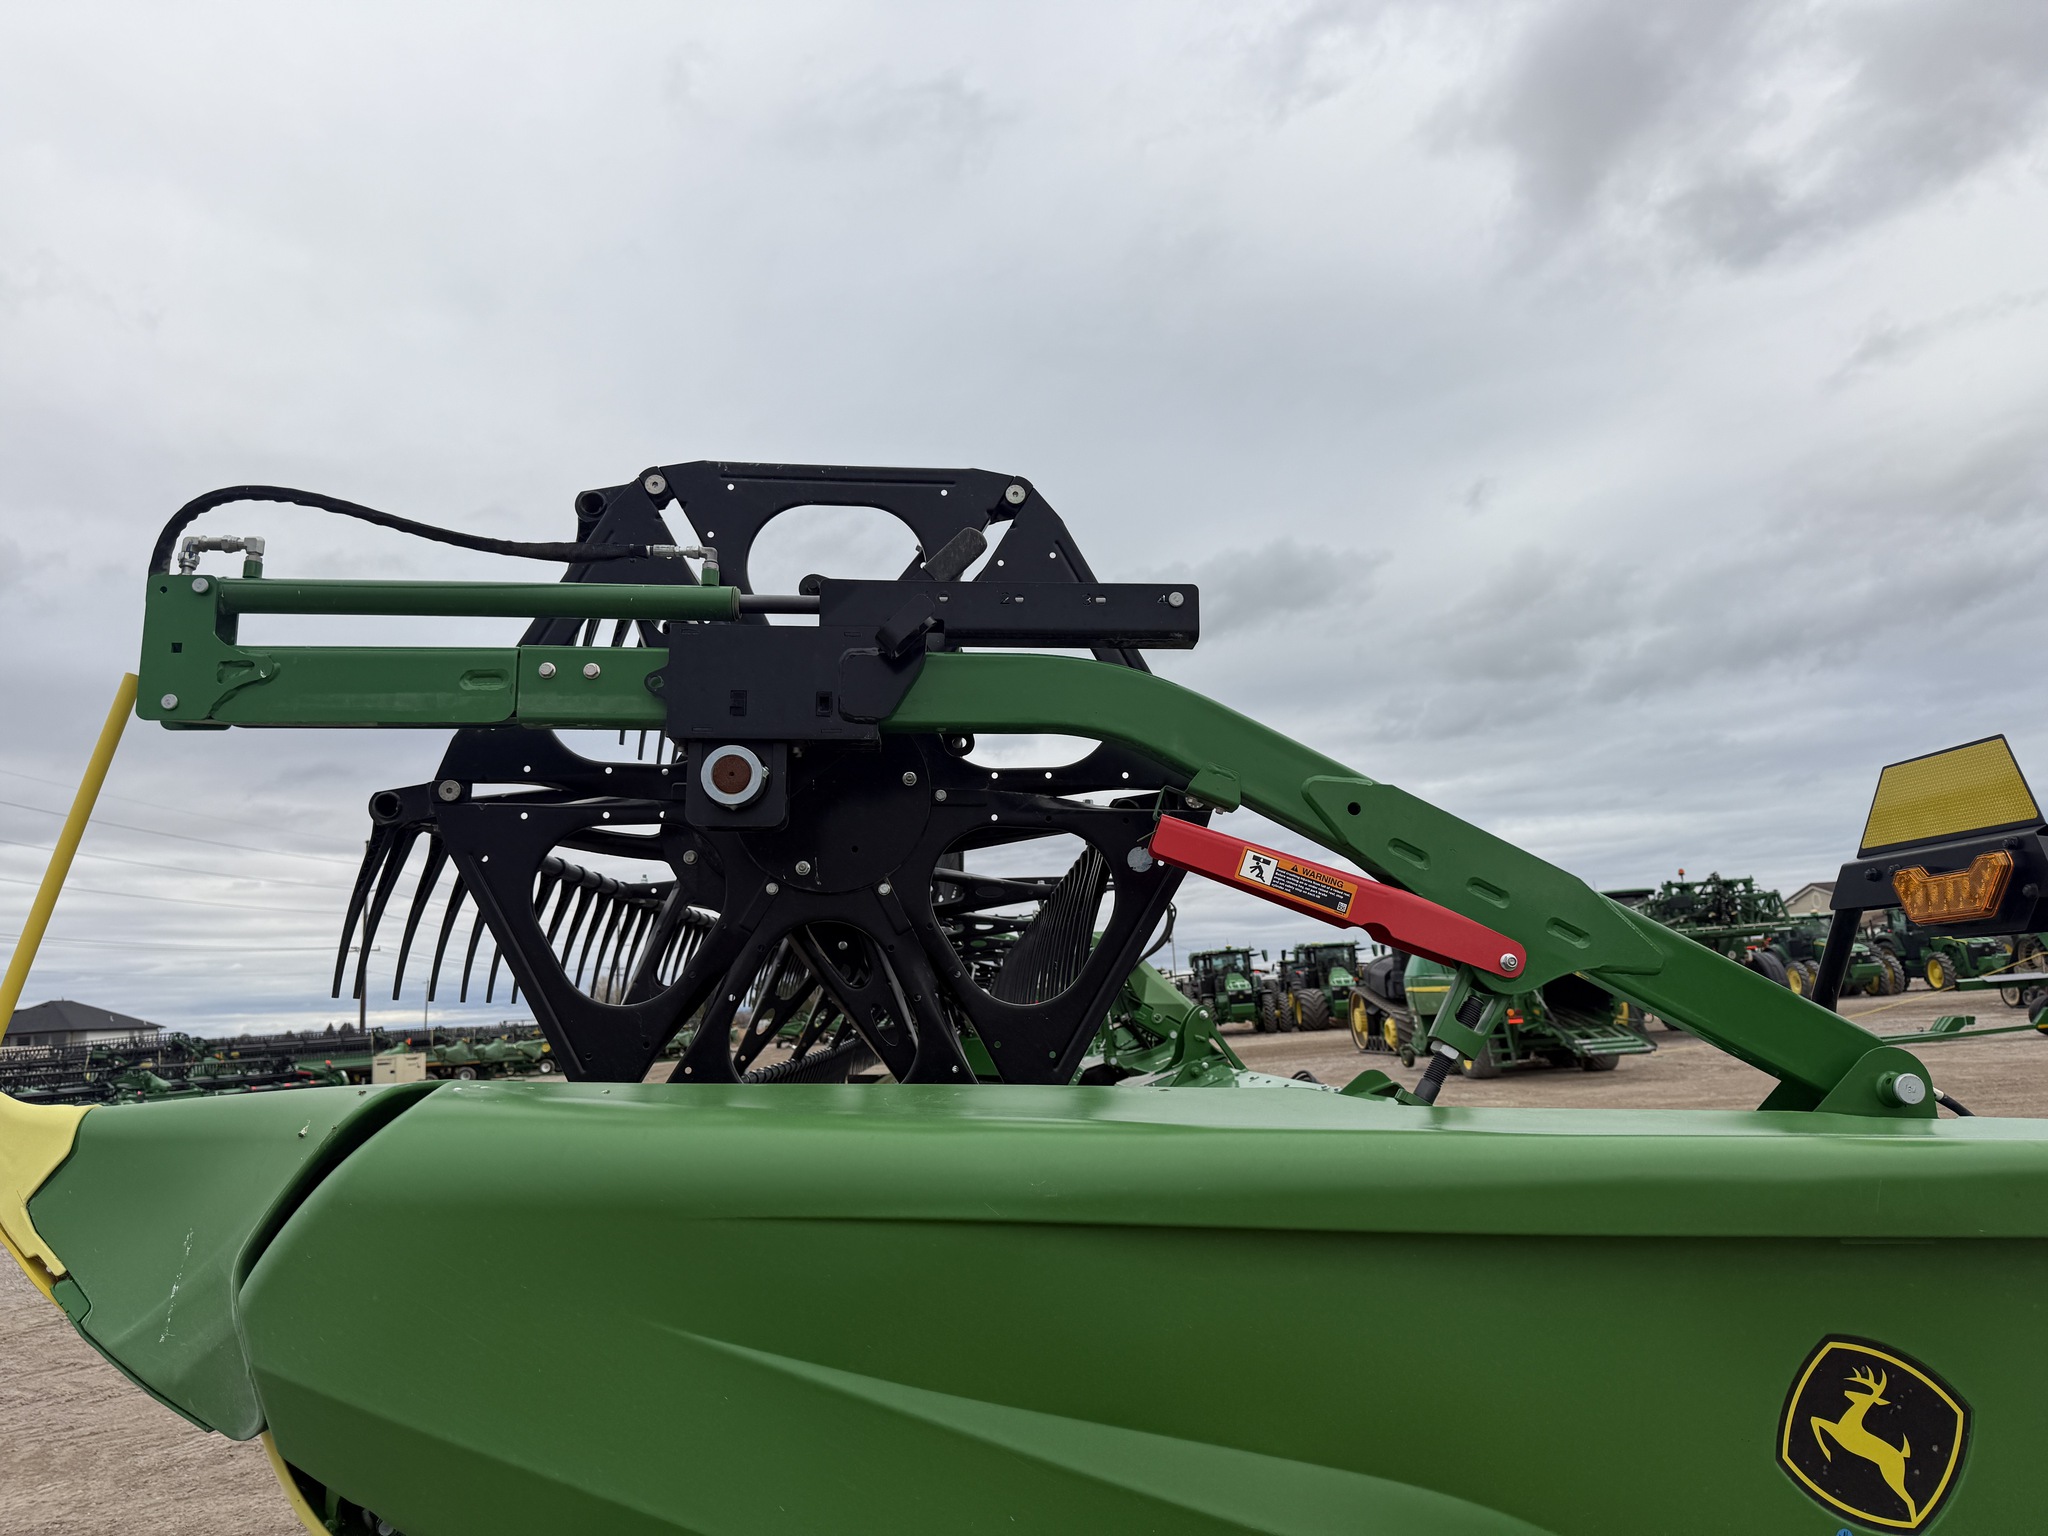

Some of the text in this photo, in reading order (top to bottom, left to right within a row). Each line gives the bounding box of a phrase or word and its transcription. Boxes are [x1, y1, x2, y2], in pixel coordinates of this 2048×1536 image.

[1000, 592, 1169, 606] 2 3 4
[1302, 868, 1344, 888] WARNING
